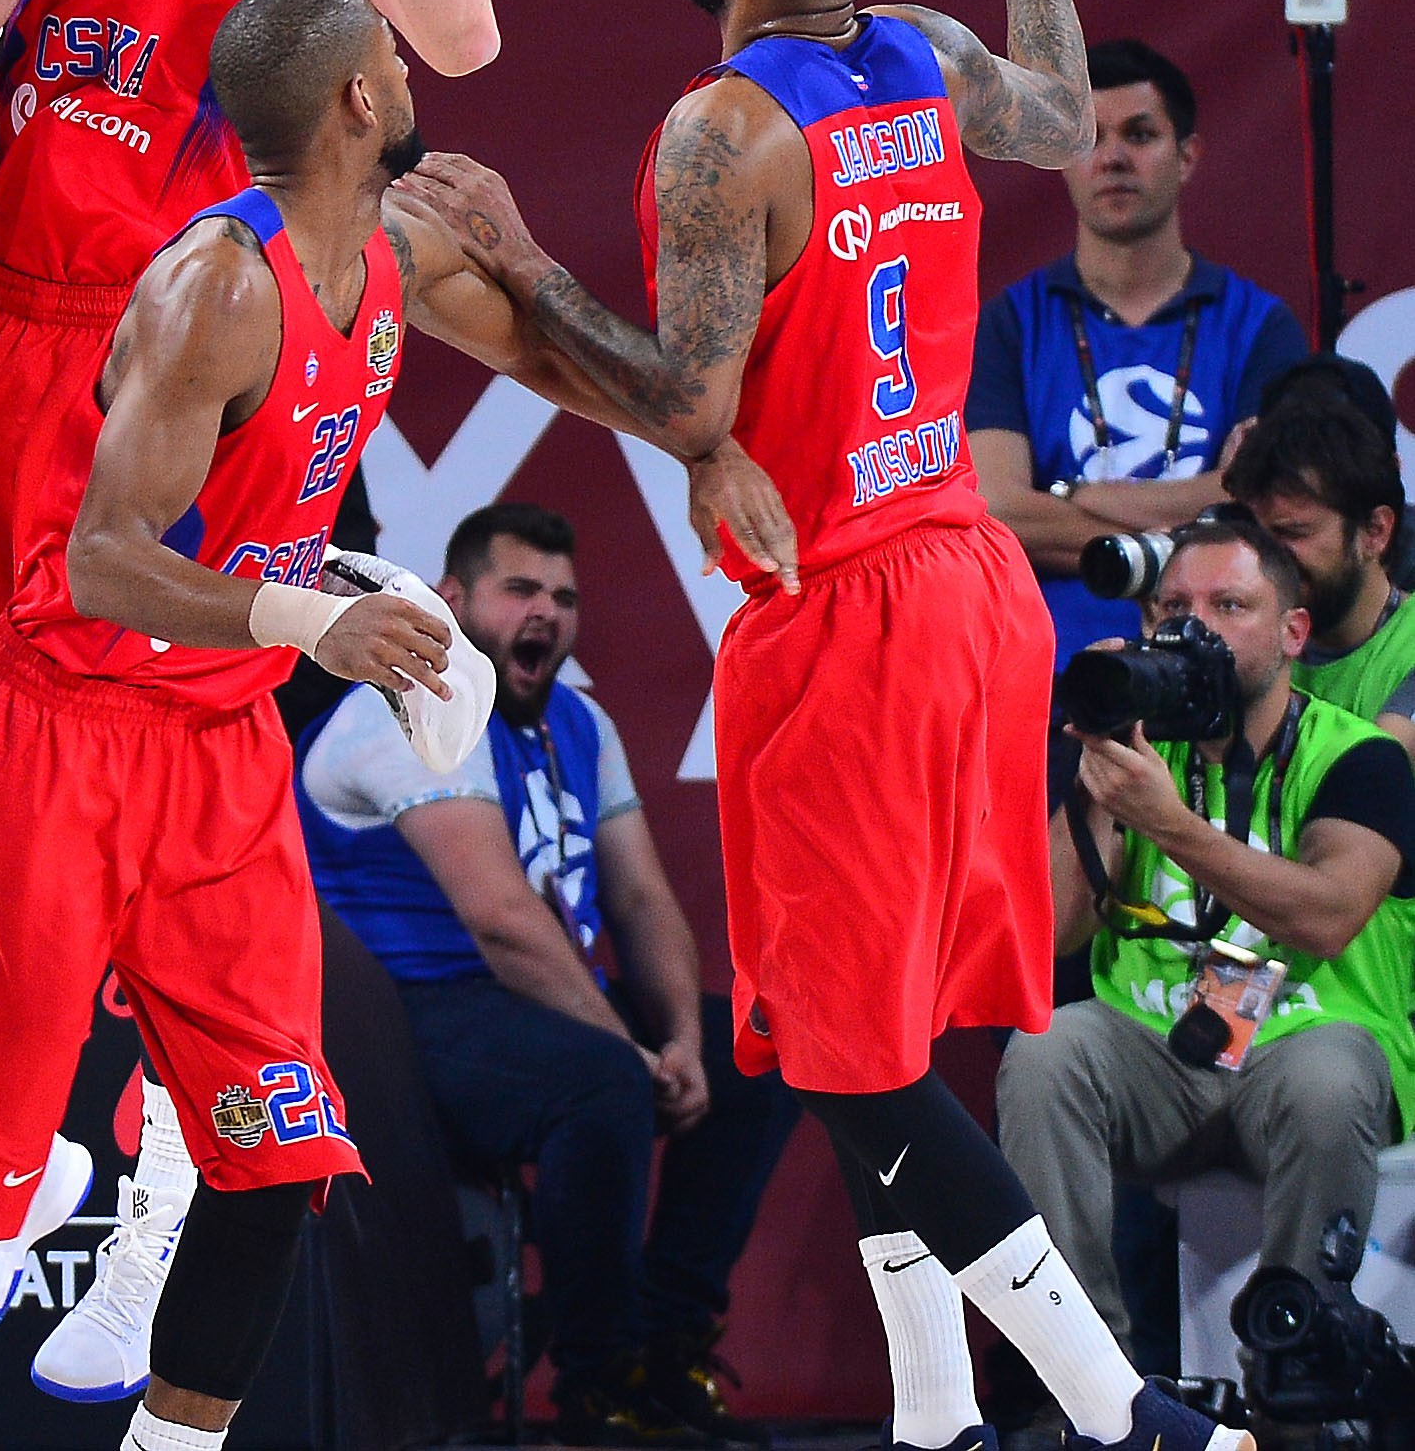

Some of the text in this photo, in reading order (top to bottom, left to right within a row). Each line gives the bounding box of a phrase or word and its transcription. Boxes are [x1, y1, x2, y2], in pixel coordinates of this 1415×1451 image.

[35, 13, 160, 98] CSKA
[866, 254, 918, 421] 9
[296, 403, 362, 505] 22
[847, 410, 960, 507] MOSCOW
[1049, 1290, 1062, 1306] 9
